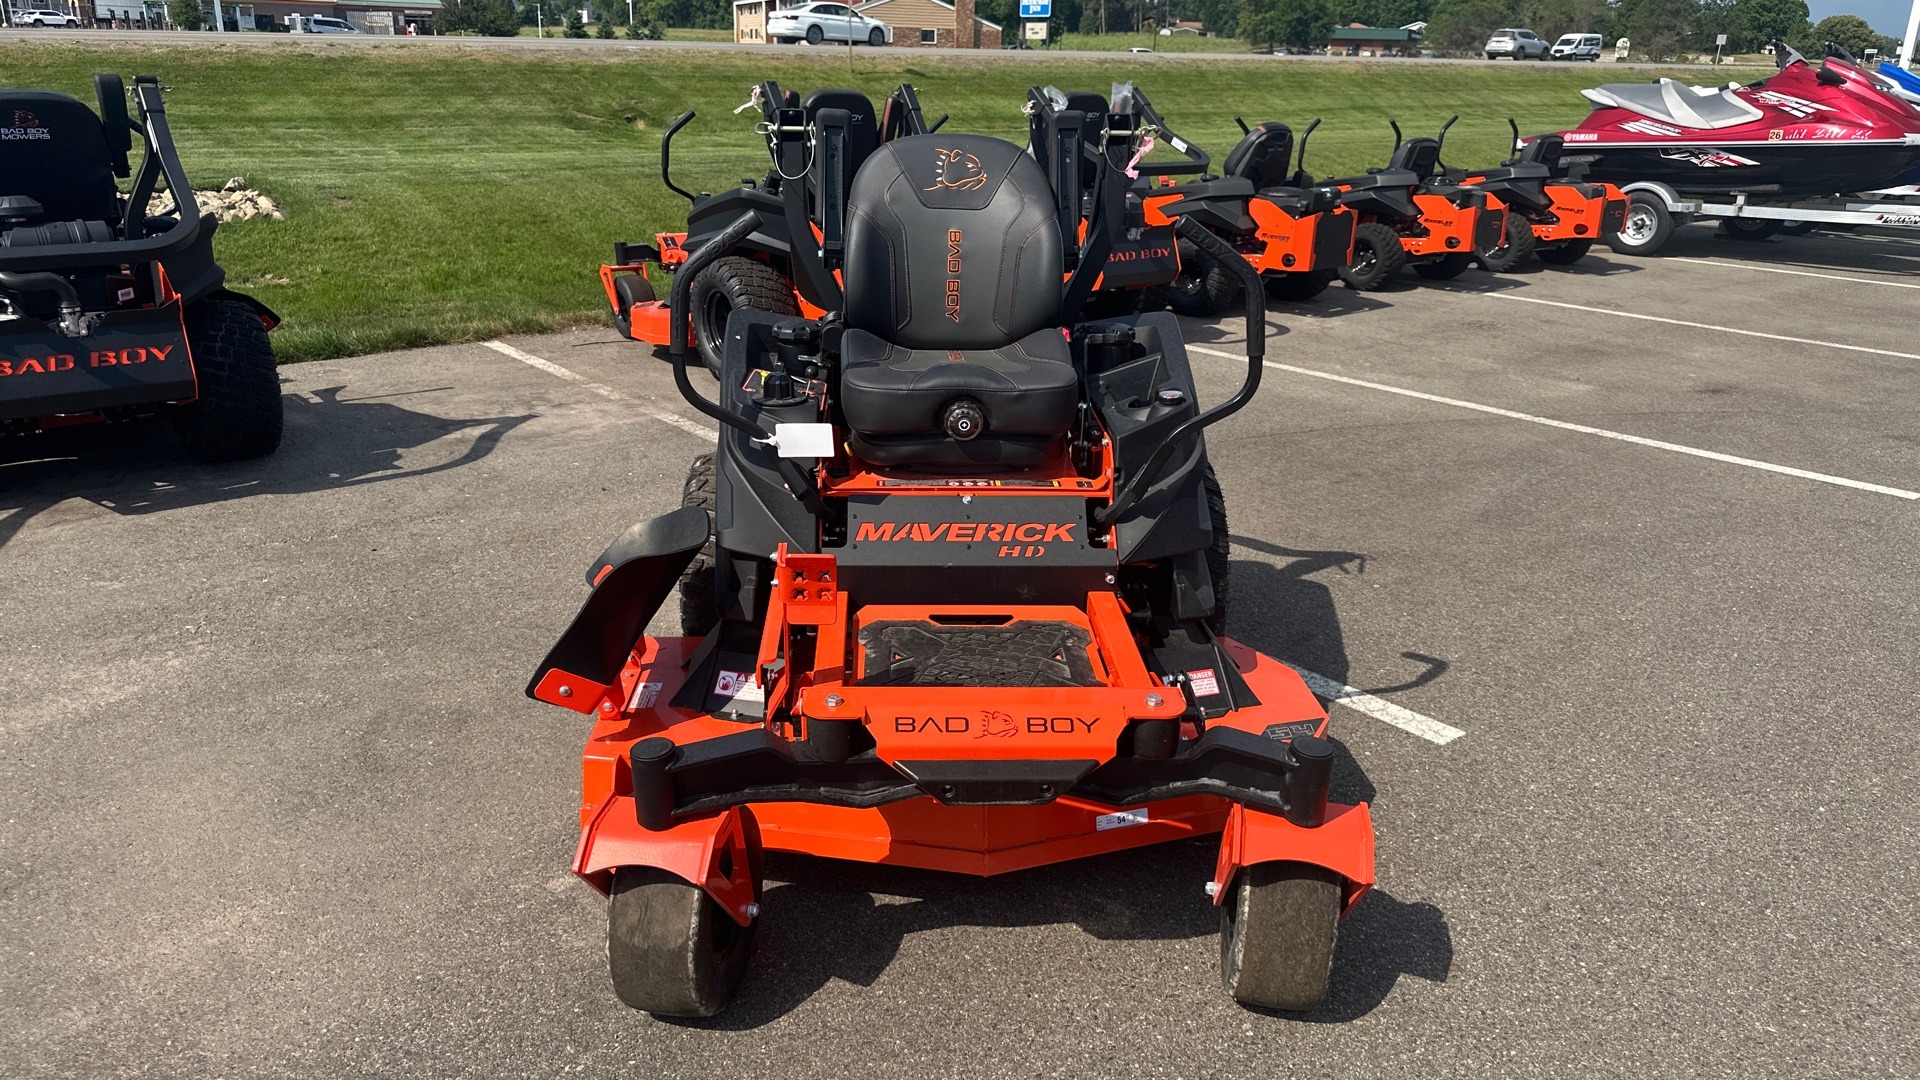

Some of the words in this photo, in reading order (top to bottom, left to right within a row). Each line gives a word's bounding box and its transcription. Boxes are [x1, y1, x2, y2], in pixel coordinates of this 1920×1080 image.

[1571, 133, 1598, 141] YAMAHA
[1769, 131, 1781, 140] 26
[948, 229, 963, 274] BAD
[1141, 246, 1171, 259] BOY
[945, 279, 961, 323] BOY
[90, 344, 174, 368] BOY
[855, 522, 1078, 542] MAVERICK
[997, 545, 1046, 558] HD
[1189, 671, 1213, 679] DANGER
[894, 716, 970, 733] BAD
[1026, 717, 1101, 734] BOY
[1266, 723, 1315, 740] 54
